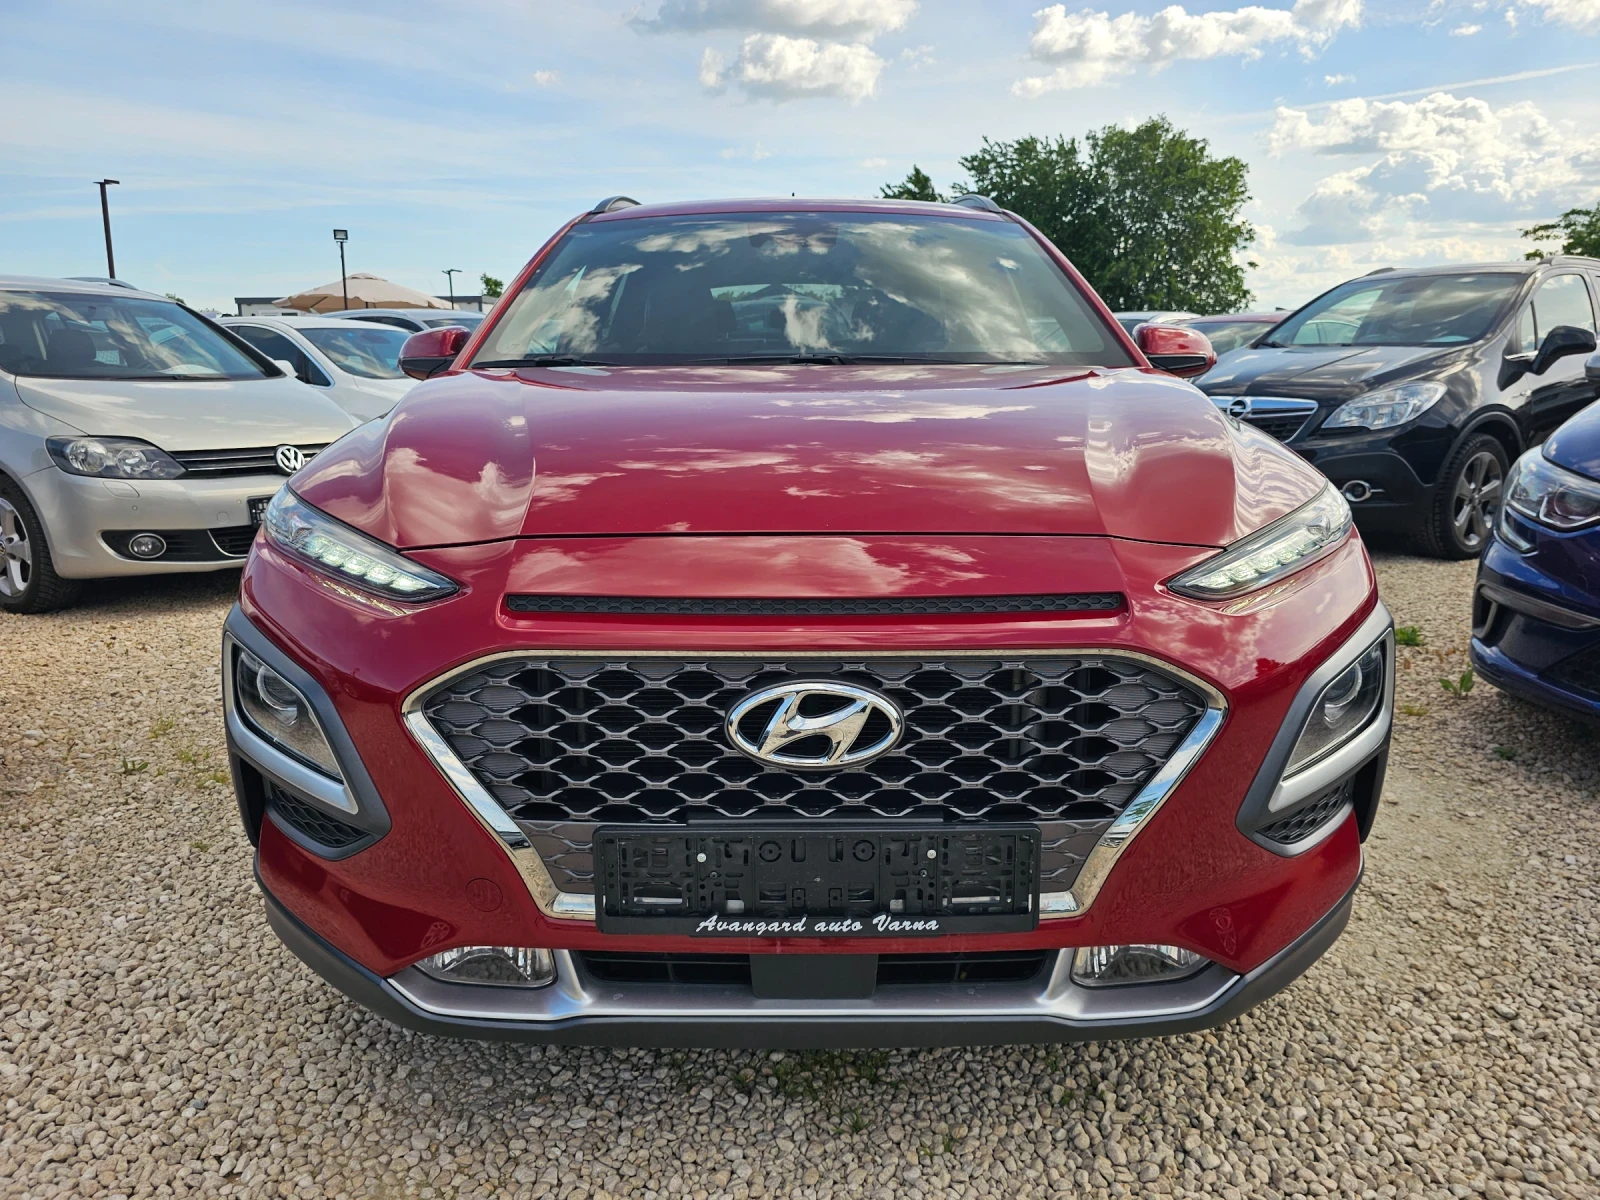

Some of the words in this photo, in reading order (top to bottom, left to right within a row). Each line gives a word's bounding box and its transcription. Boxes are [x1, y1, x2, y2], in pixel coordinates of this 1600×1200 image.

[696, 914, 807, 936] Avangard
[814, 917, 863, 932] auto
[872, 914, 940, 932] Varna
